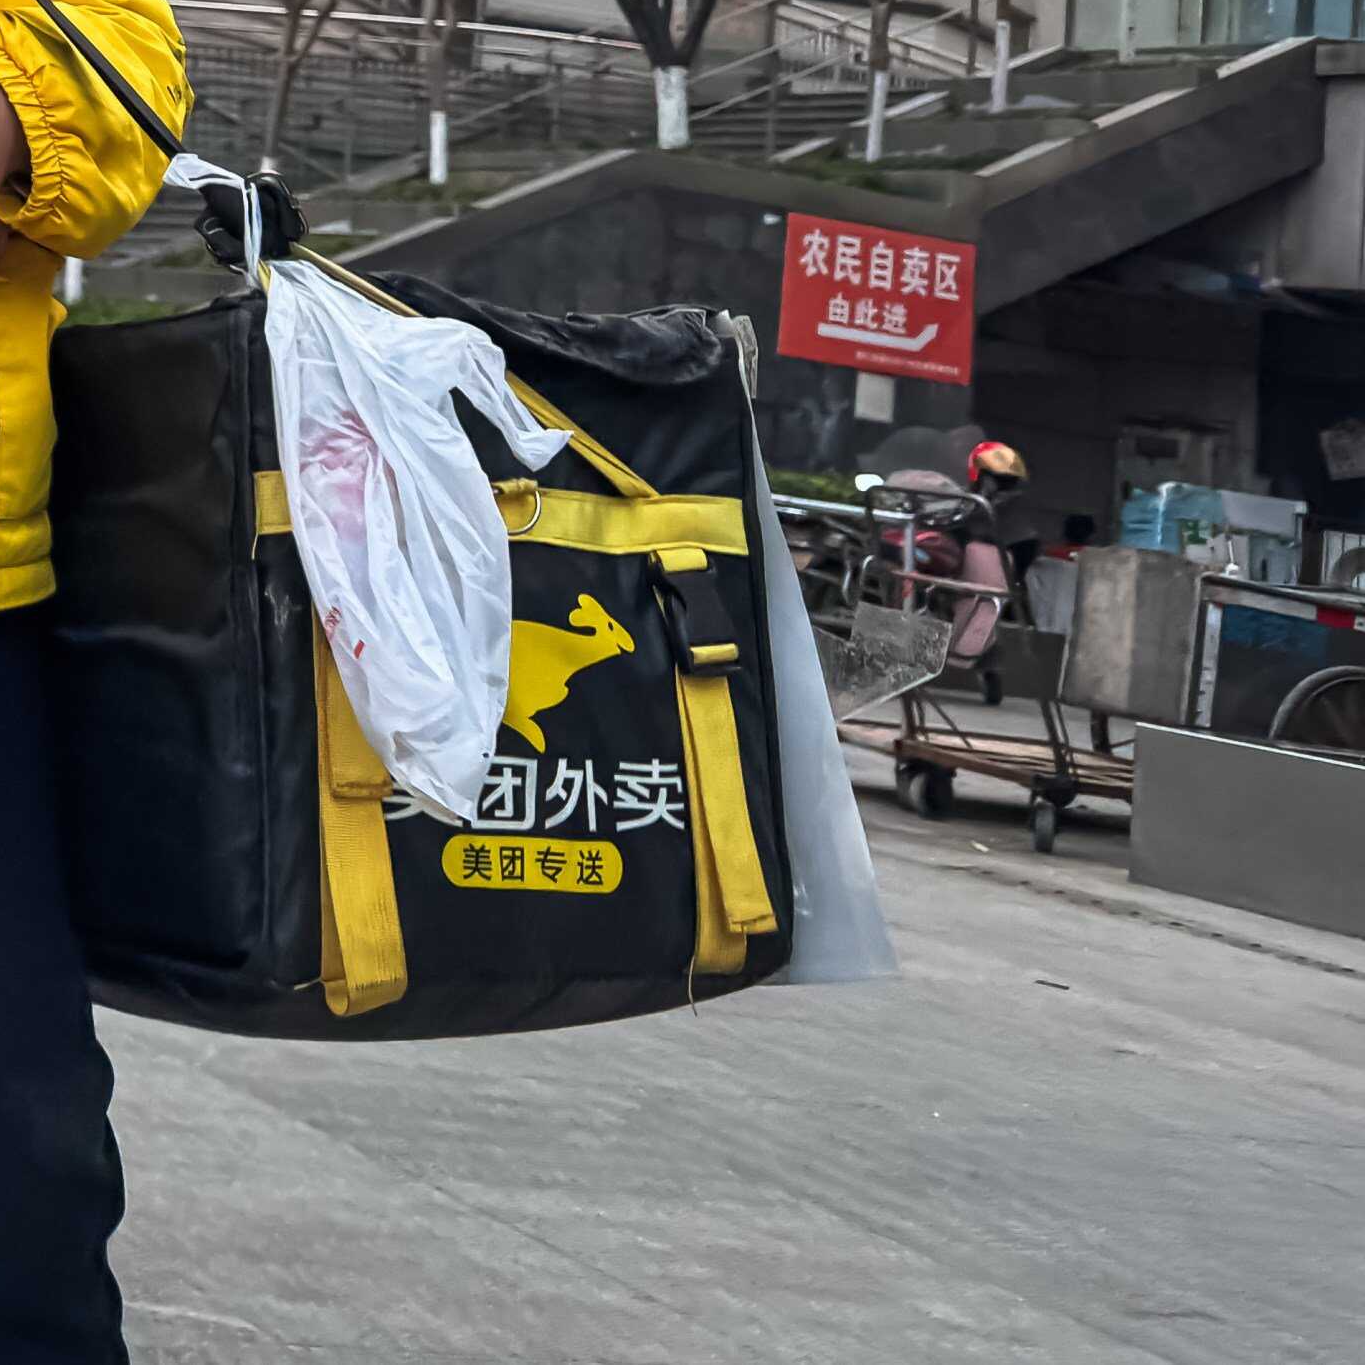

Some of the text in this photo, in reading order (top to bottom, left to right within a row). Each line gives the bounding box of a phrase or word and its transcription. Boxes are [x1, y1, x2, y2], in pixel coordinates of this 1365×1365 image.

[799, 228, 962, 303] 农民自卖区
[827, 291, 909, 335] 由此进
[462, 842, 604, 887] 美团专送
